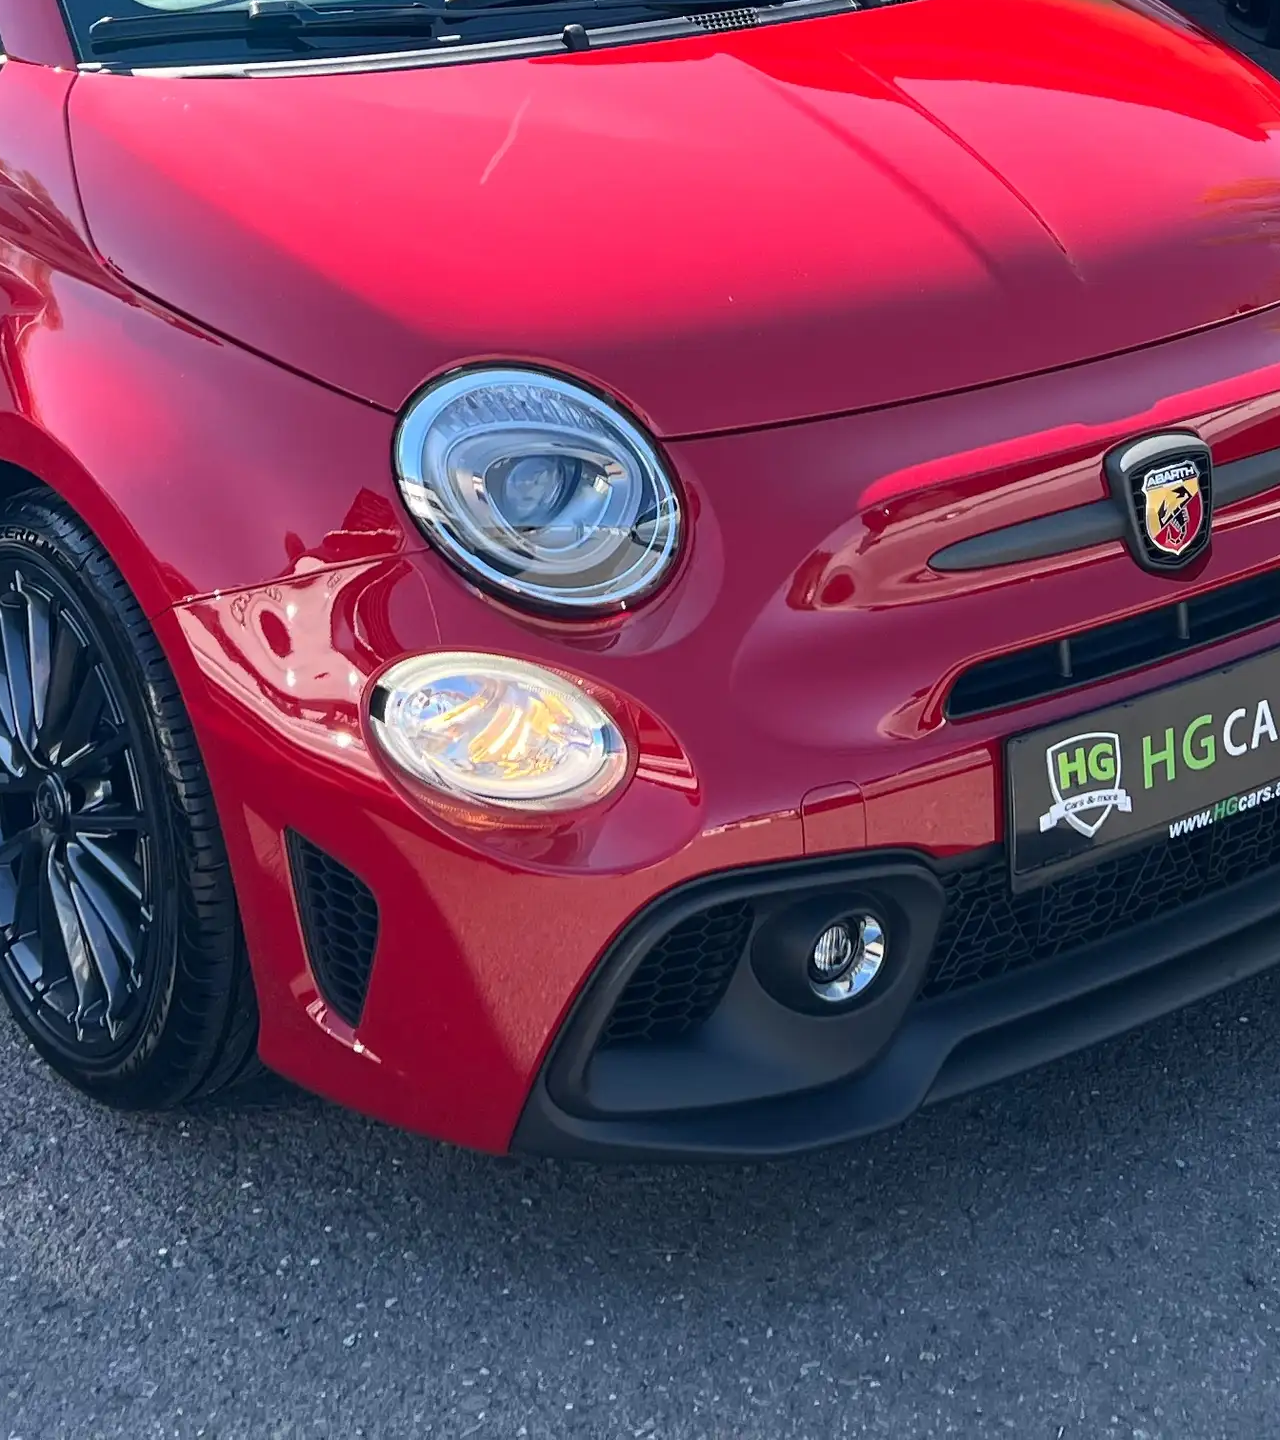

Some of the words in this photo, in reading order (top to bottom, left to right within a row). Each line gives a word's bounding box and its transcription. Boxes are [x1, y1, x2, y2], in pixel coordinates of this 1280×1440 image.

[1147, 466, 1195, 488] ABARTH
[1058, 742, 1115, 790] HG
[1065, 800, 1085, 811] Cars
[1098, 794, 1118, 802] more
